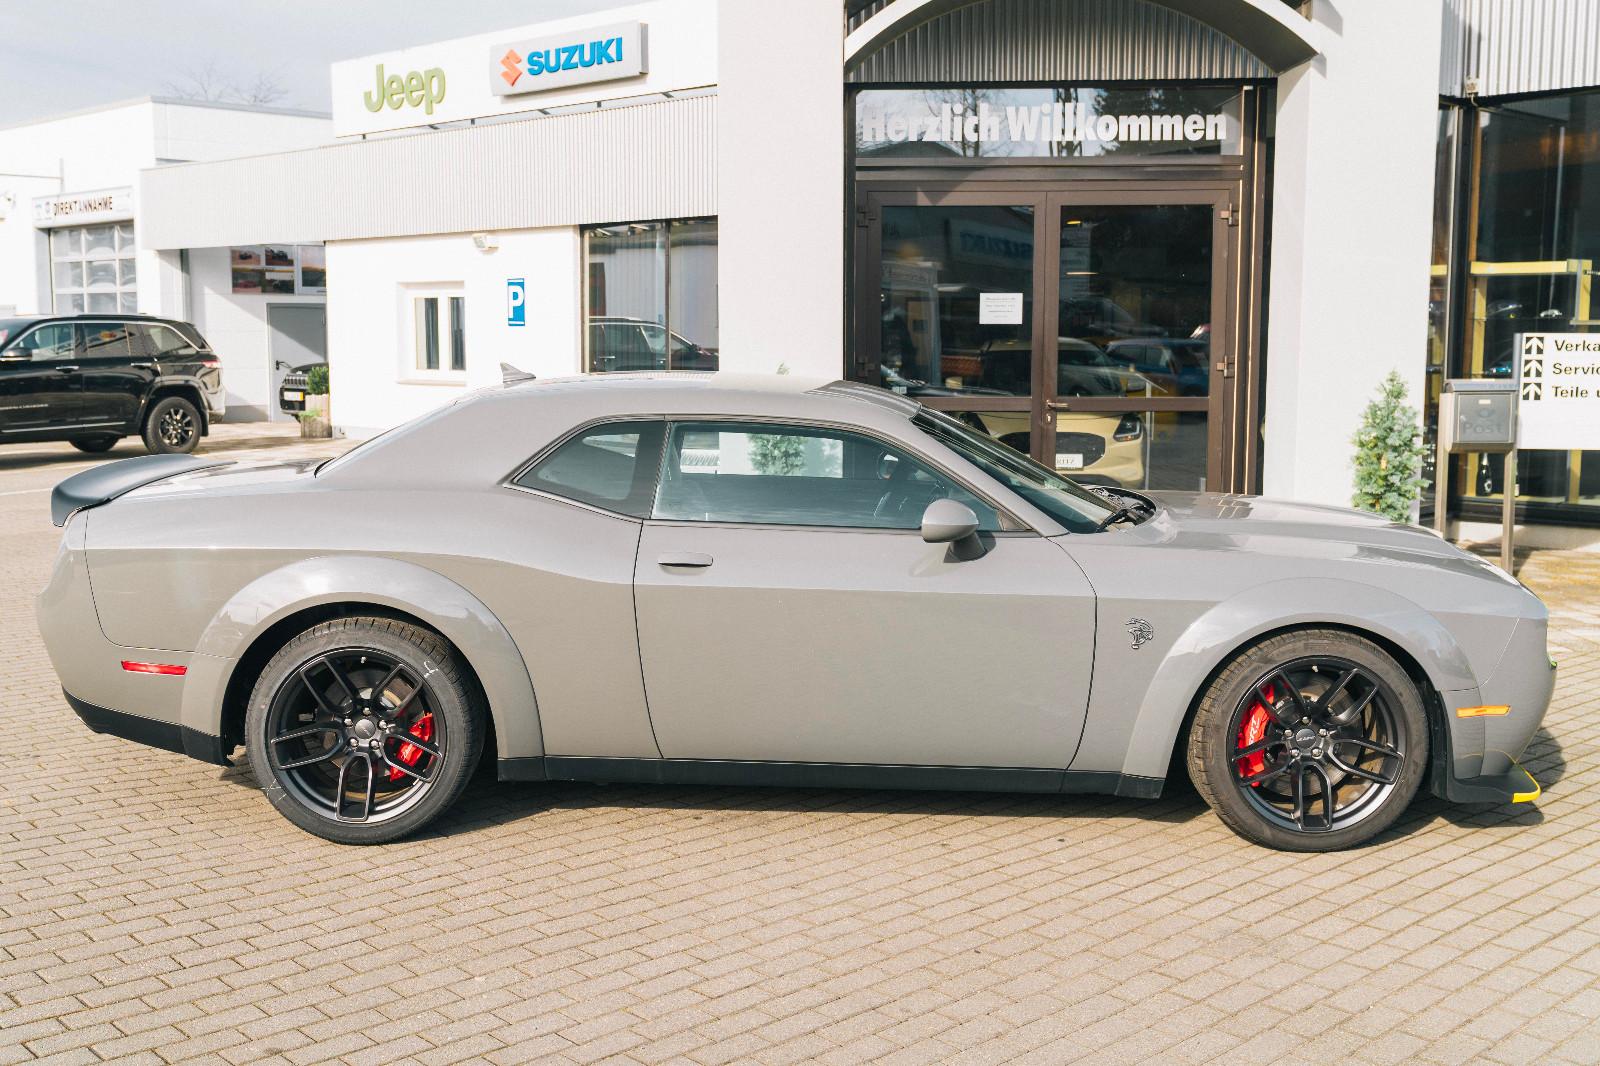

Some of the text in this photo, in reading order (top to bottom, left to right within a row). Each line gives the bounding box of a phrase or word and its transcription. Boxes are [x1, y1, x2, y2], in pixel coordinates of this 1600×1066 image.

[527, 37, 623, 76] SUZUKI
[363, 63, 446, 115] Jeep
[862, 102, 1227, 142] Herzlich Willkommen
[508, 285, 525, 319] P
[1554, 339, 1600, 352] Verka
[1551, 385, 1589, 398] Teile
